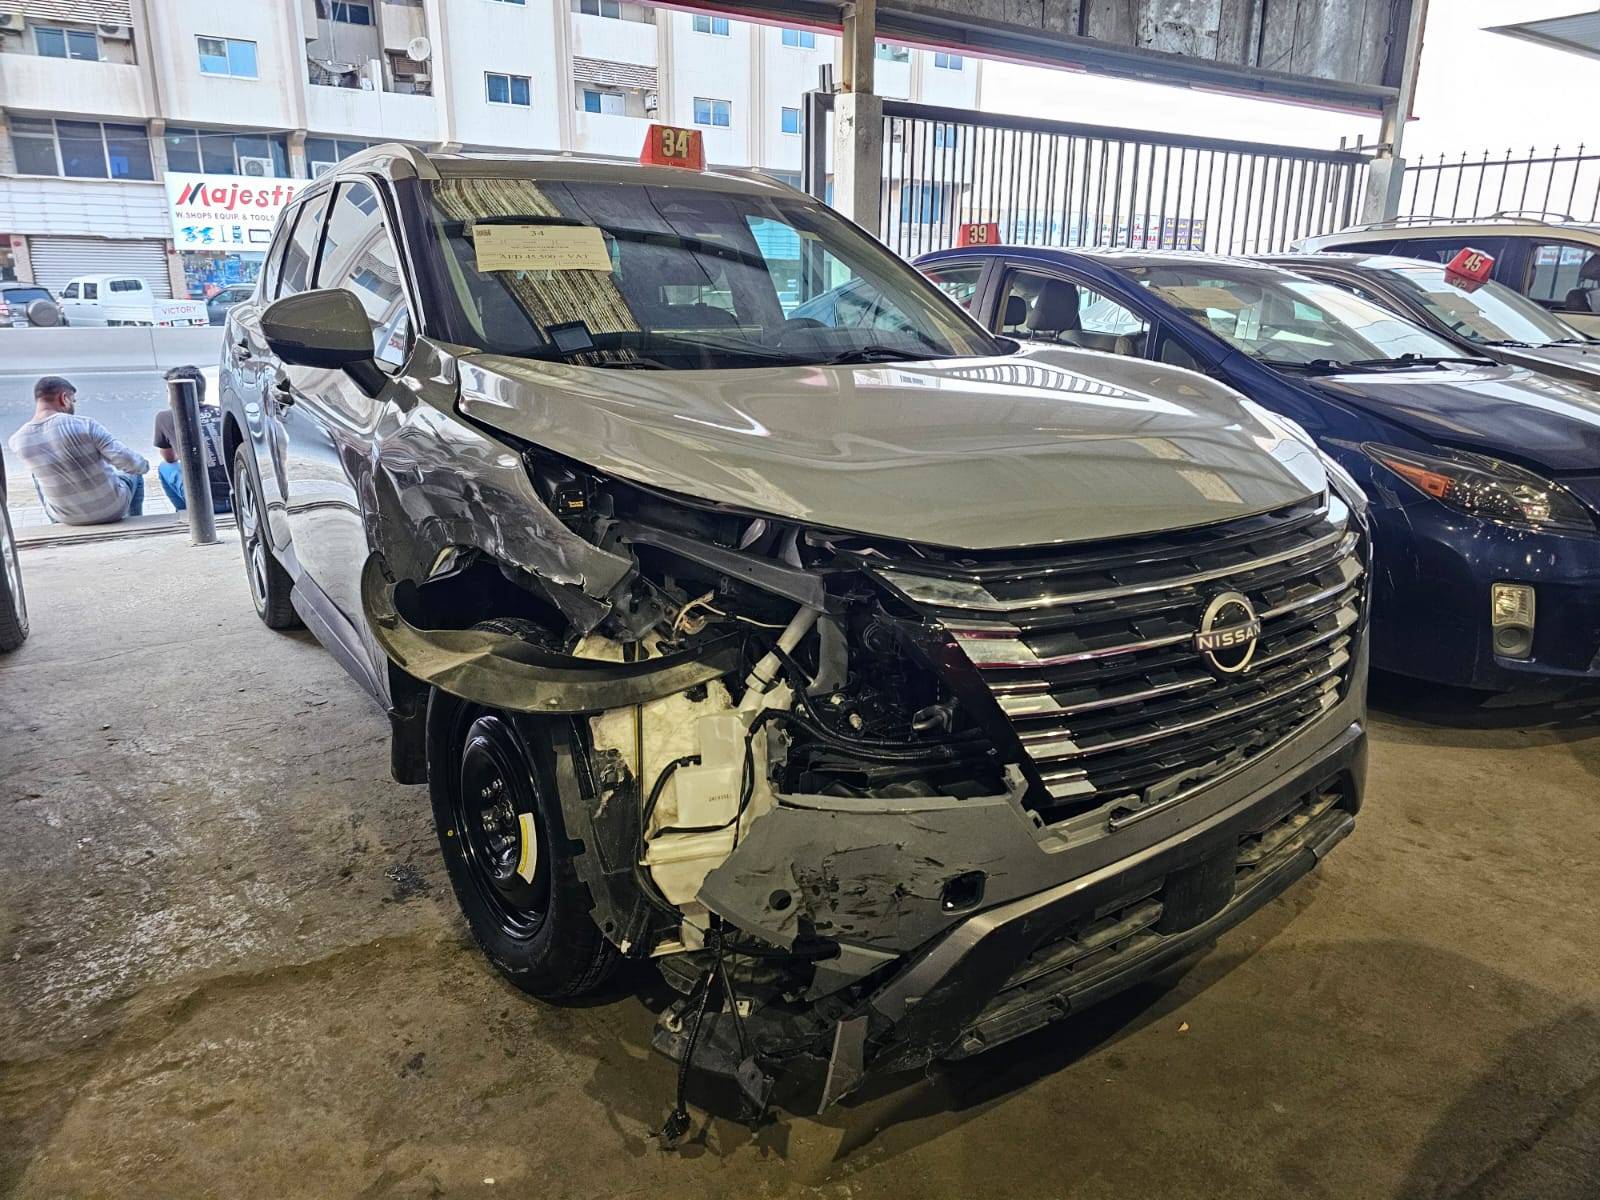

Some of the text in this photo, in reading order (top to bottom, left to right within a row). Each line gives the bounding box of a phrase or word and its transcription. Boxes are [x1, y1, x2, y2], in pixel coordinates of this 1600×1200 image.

[662, 128, 688, 158] 34
[242, 213, 248, 221] &
[250, 213, 276, 222] TOOLS
[529, 229, 545, 237] 34
[970, 224, 987, 244] 39
[1463, 253, 1485, 272] 45
[161, 305, 197, 315] VICTORY
[1199, 622, 1261, 650] NISSAN
